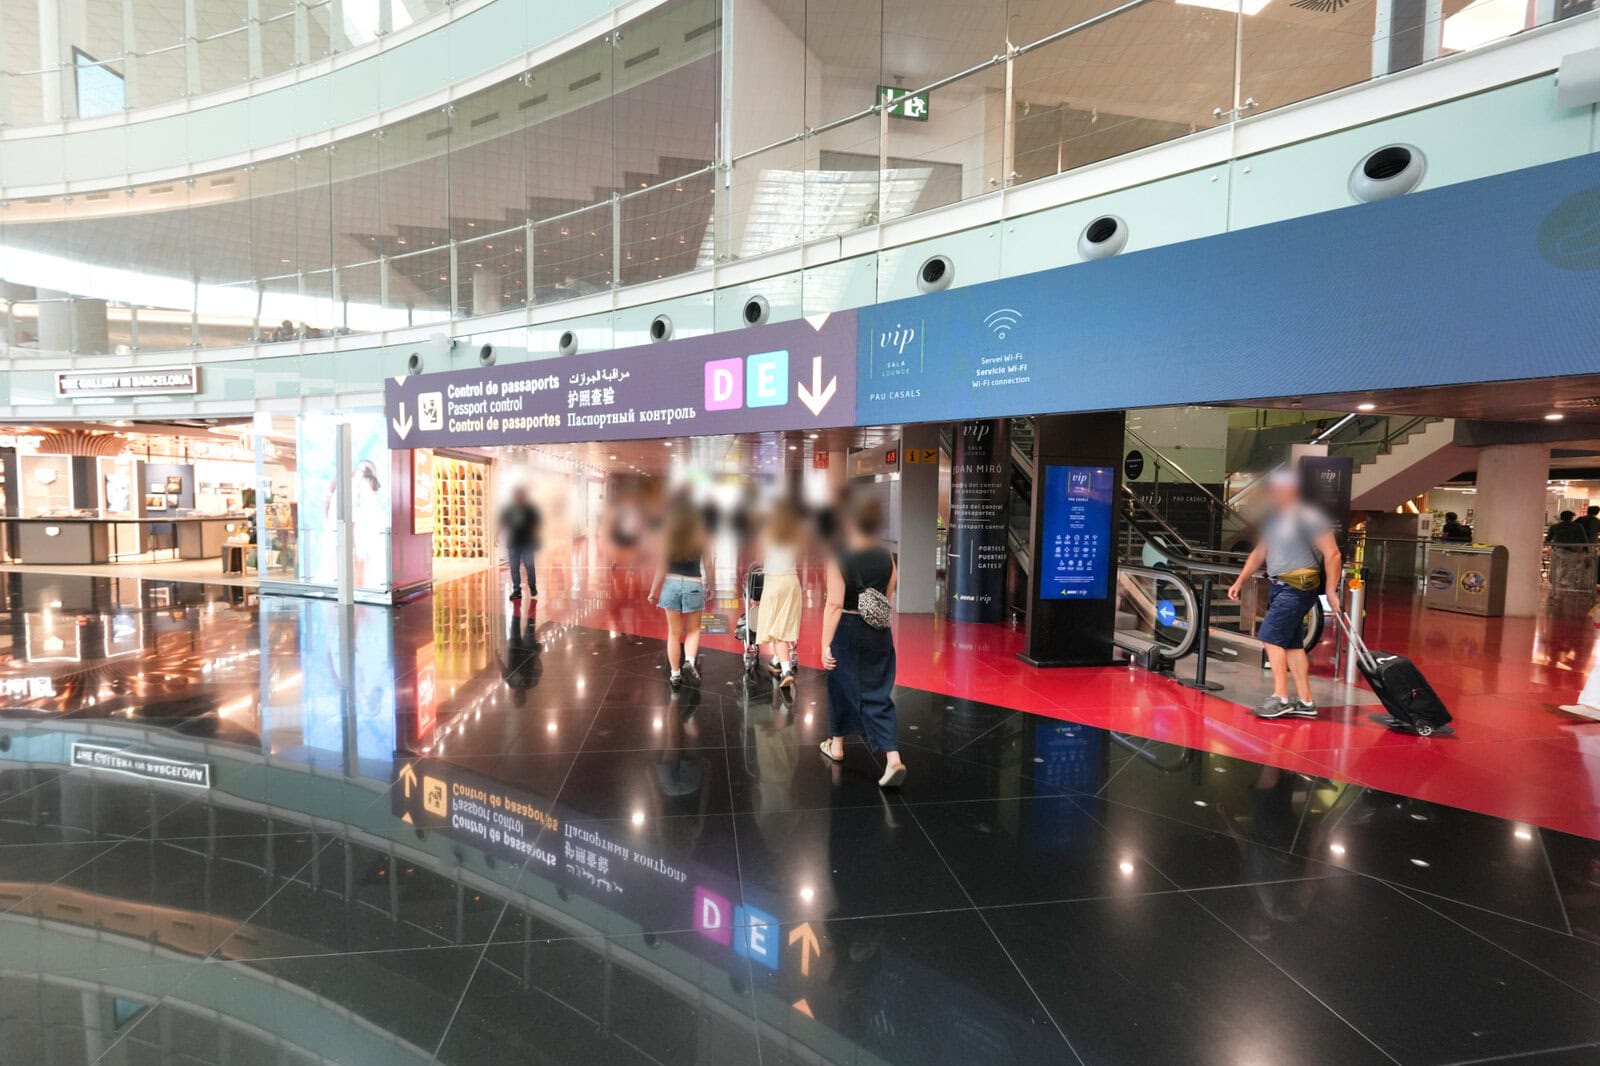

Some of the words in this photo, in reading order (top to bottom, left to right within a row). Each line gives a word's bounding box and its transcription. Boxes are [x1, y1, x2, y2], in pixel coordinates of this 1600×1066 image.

[880, 323, 915, 354] vip
[132, 374, 191, 387] BARCELONA
[713, 368, 733, 402] D
[757, 361, 776, 397] E
[976, 366, 1006, 377] Servicio
[991, 376, 1031, 386] connection
[447, 381, 483, 399] Control
[485, 380, 498, 396] de
[501, 375, 560, 397] passaports
[568, 386, 615, 408] 护照查验
[870, 392, 886, 401] PAU
[889, 389, 921, 400] CASALS
[448, 400, 487, 416] Passport
[490, 396, 522, 413] control
[448, 416, 484, 433] Control
[486, 416, 499, 430] de
[502, 413, 561, 433] pasaportes
[567, 408, 635, 429] Паспортный
[639, 407, 696, 425] контроль
[963, 421, 990, 442] vip
[976, 463, 1002, 474] MIRÓ
[1072, 472, 1088, 484] vip
